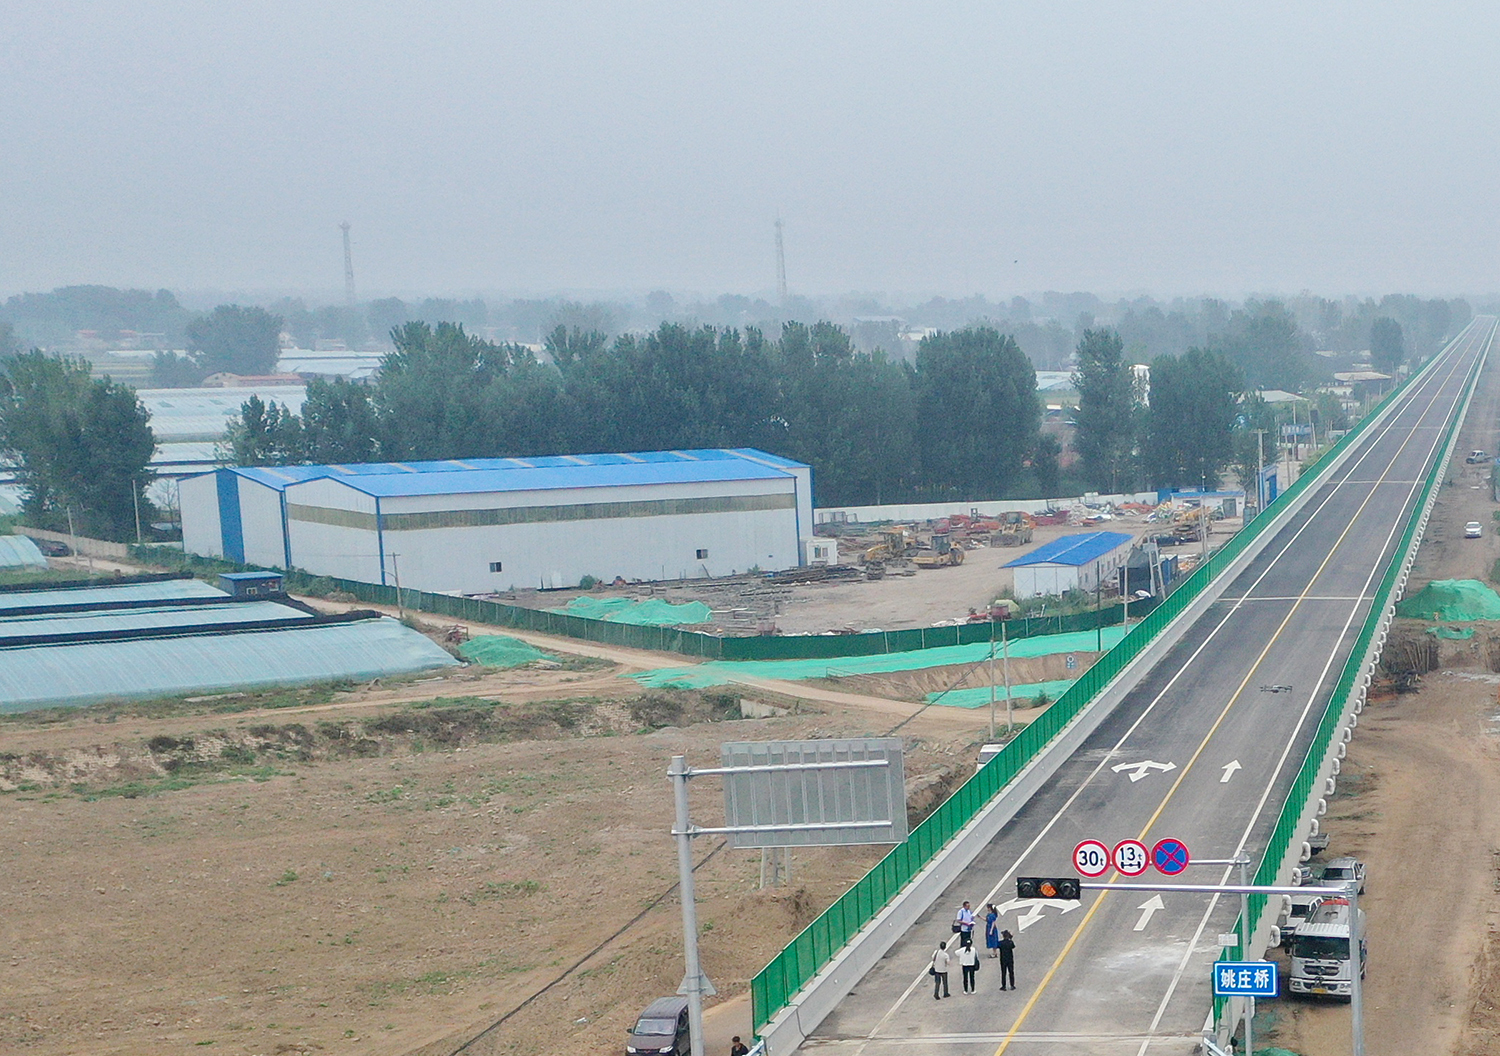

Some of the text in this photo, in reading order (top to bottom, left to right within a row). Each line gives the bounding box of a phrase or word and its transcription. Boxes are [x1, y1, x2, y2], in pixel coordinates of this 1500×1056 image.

[1078, 850, 1104, 867] 30t
[1119, 847, 1142, 861] 13t
[1220, 968, 1270, 989] 姚庄桥
